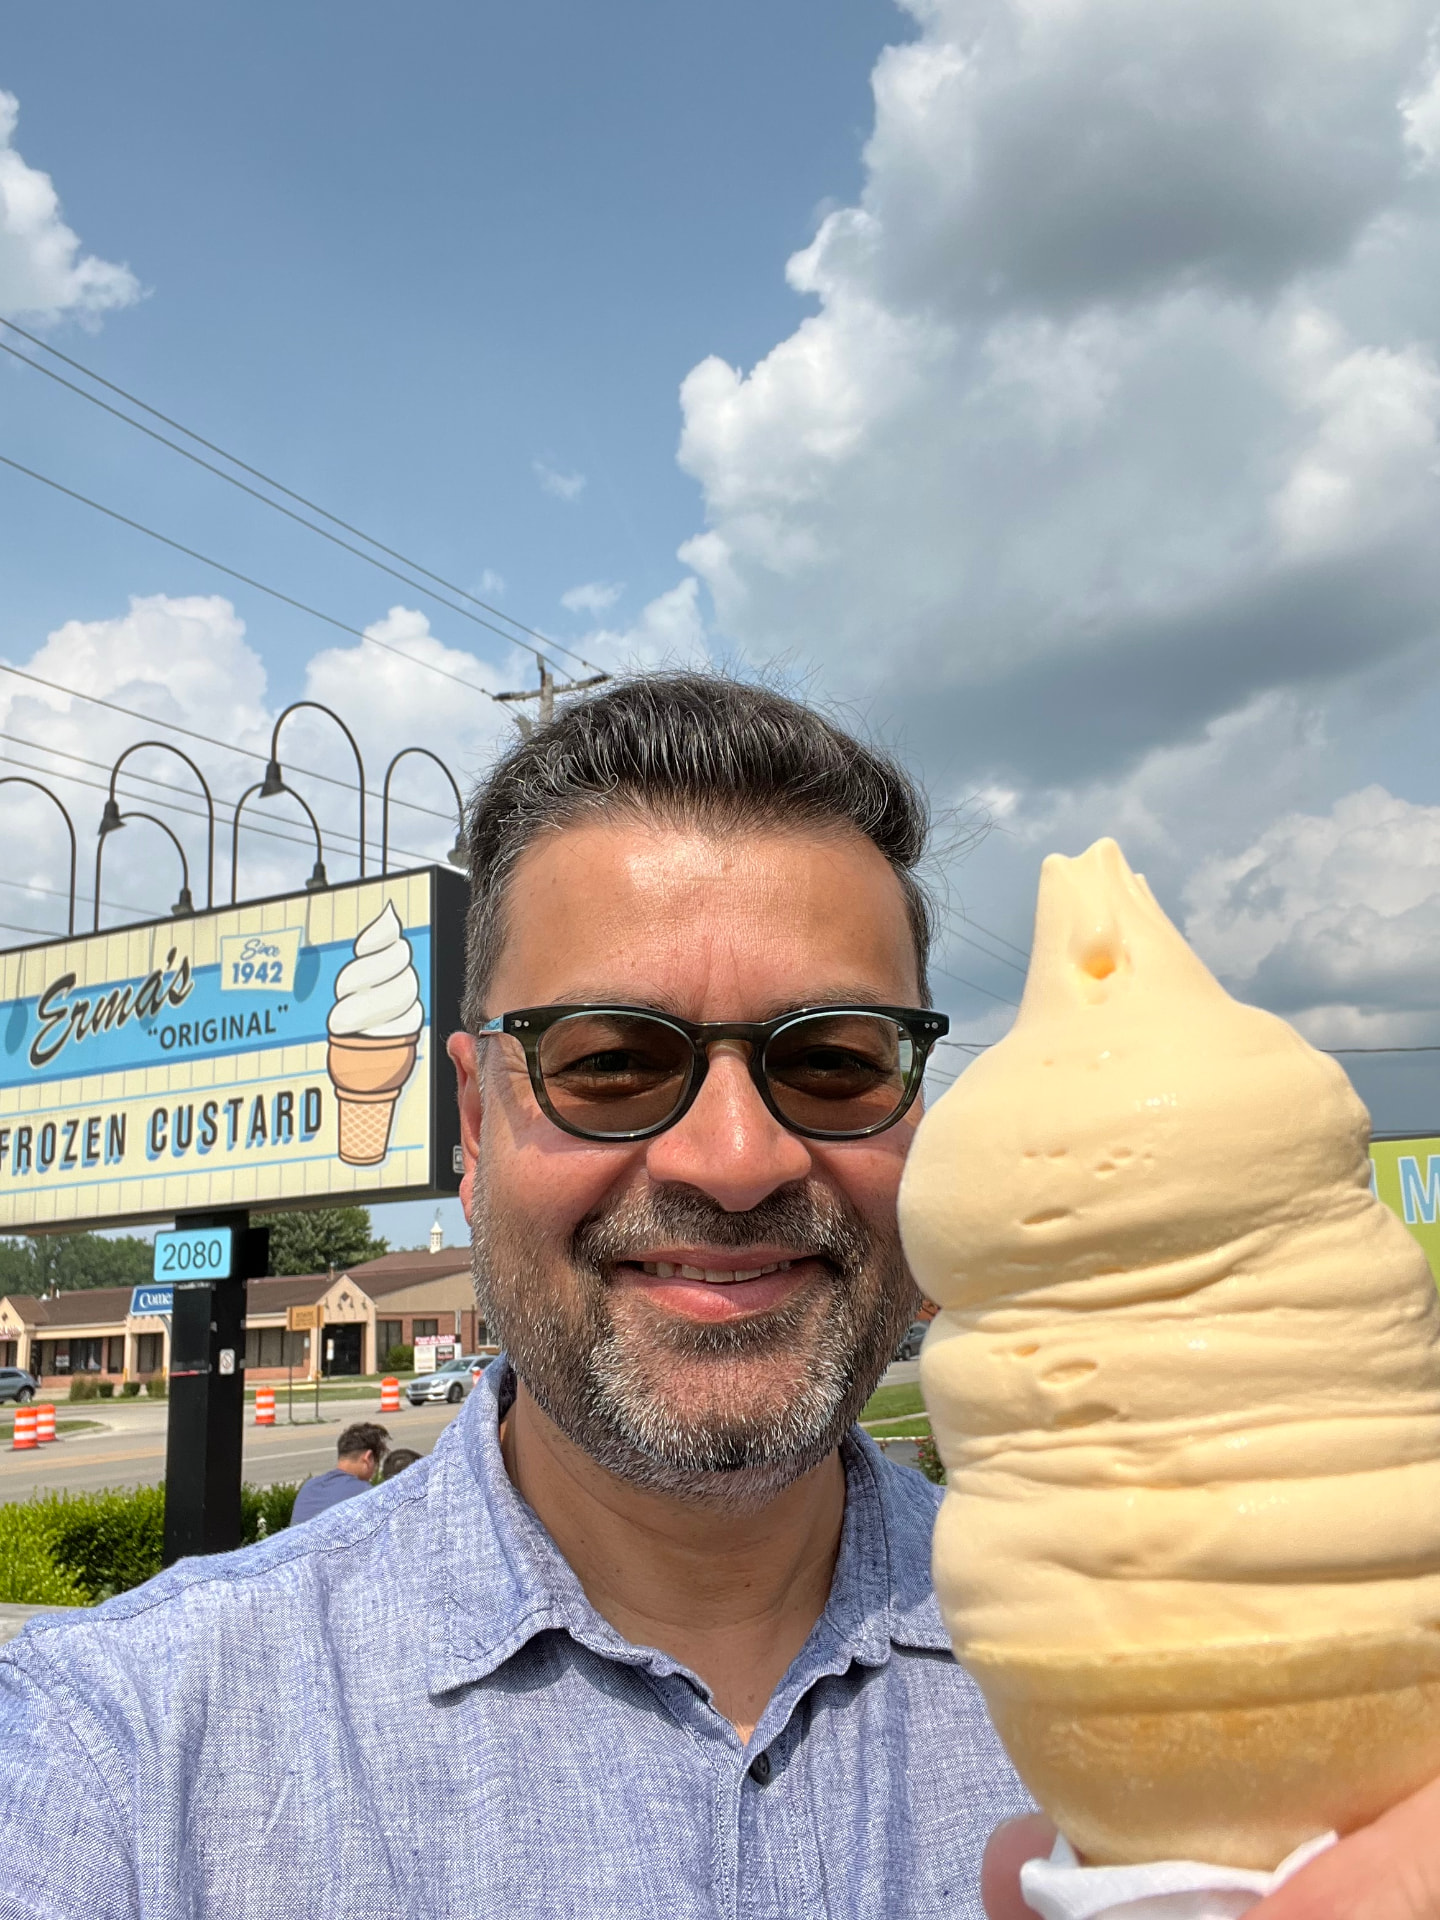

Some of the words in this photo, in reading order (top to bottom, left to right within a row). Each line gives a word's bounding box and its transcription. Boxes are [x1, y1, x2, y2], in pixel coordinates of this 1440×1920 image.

[240, 937, 281, 960] Since
[231, 962, 283, 985] 1942
[29, 947, 195, 1068] Erma's
[148, 1004, 290, 1050] "ORIGINAL"
[0, 1113, 127, 1174] FROZEN
[148, 1087, 323, 1161] CUSTARD
[162, 1240, 223, 1272] 2080
